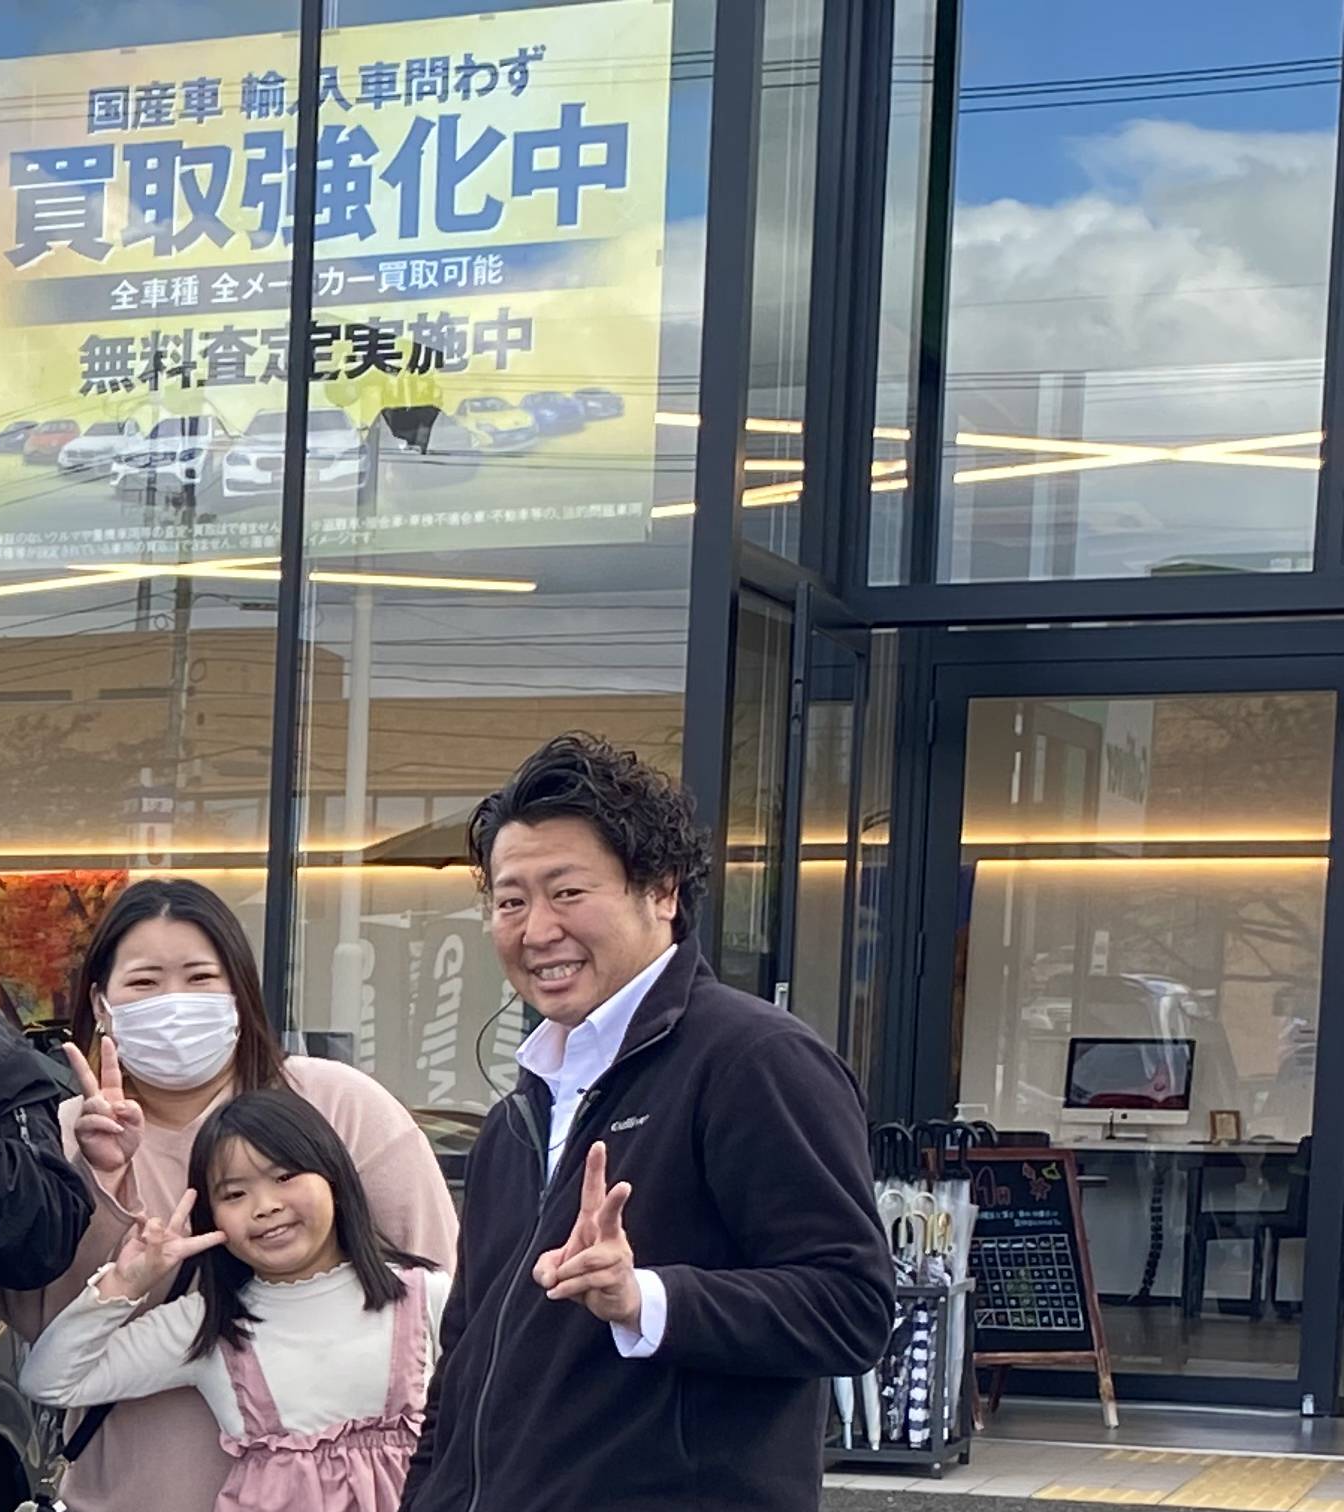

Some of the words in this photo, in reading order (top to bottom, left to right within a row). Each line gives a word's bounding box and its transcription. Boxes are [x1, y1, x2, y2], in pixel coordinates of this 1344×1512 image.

[87, 77, 223, 135] 国産車
[240, 45, 547, 121] 輸入車問わず
[3, 102, 630, 271] 買取強化中
[109, 277, 200, 311] 全車種
[211, 254, 504, 304] 全メーカー買取可能
[77, 307, 535, 396] 無料査定実施中
